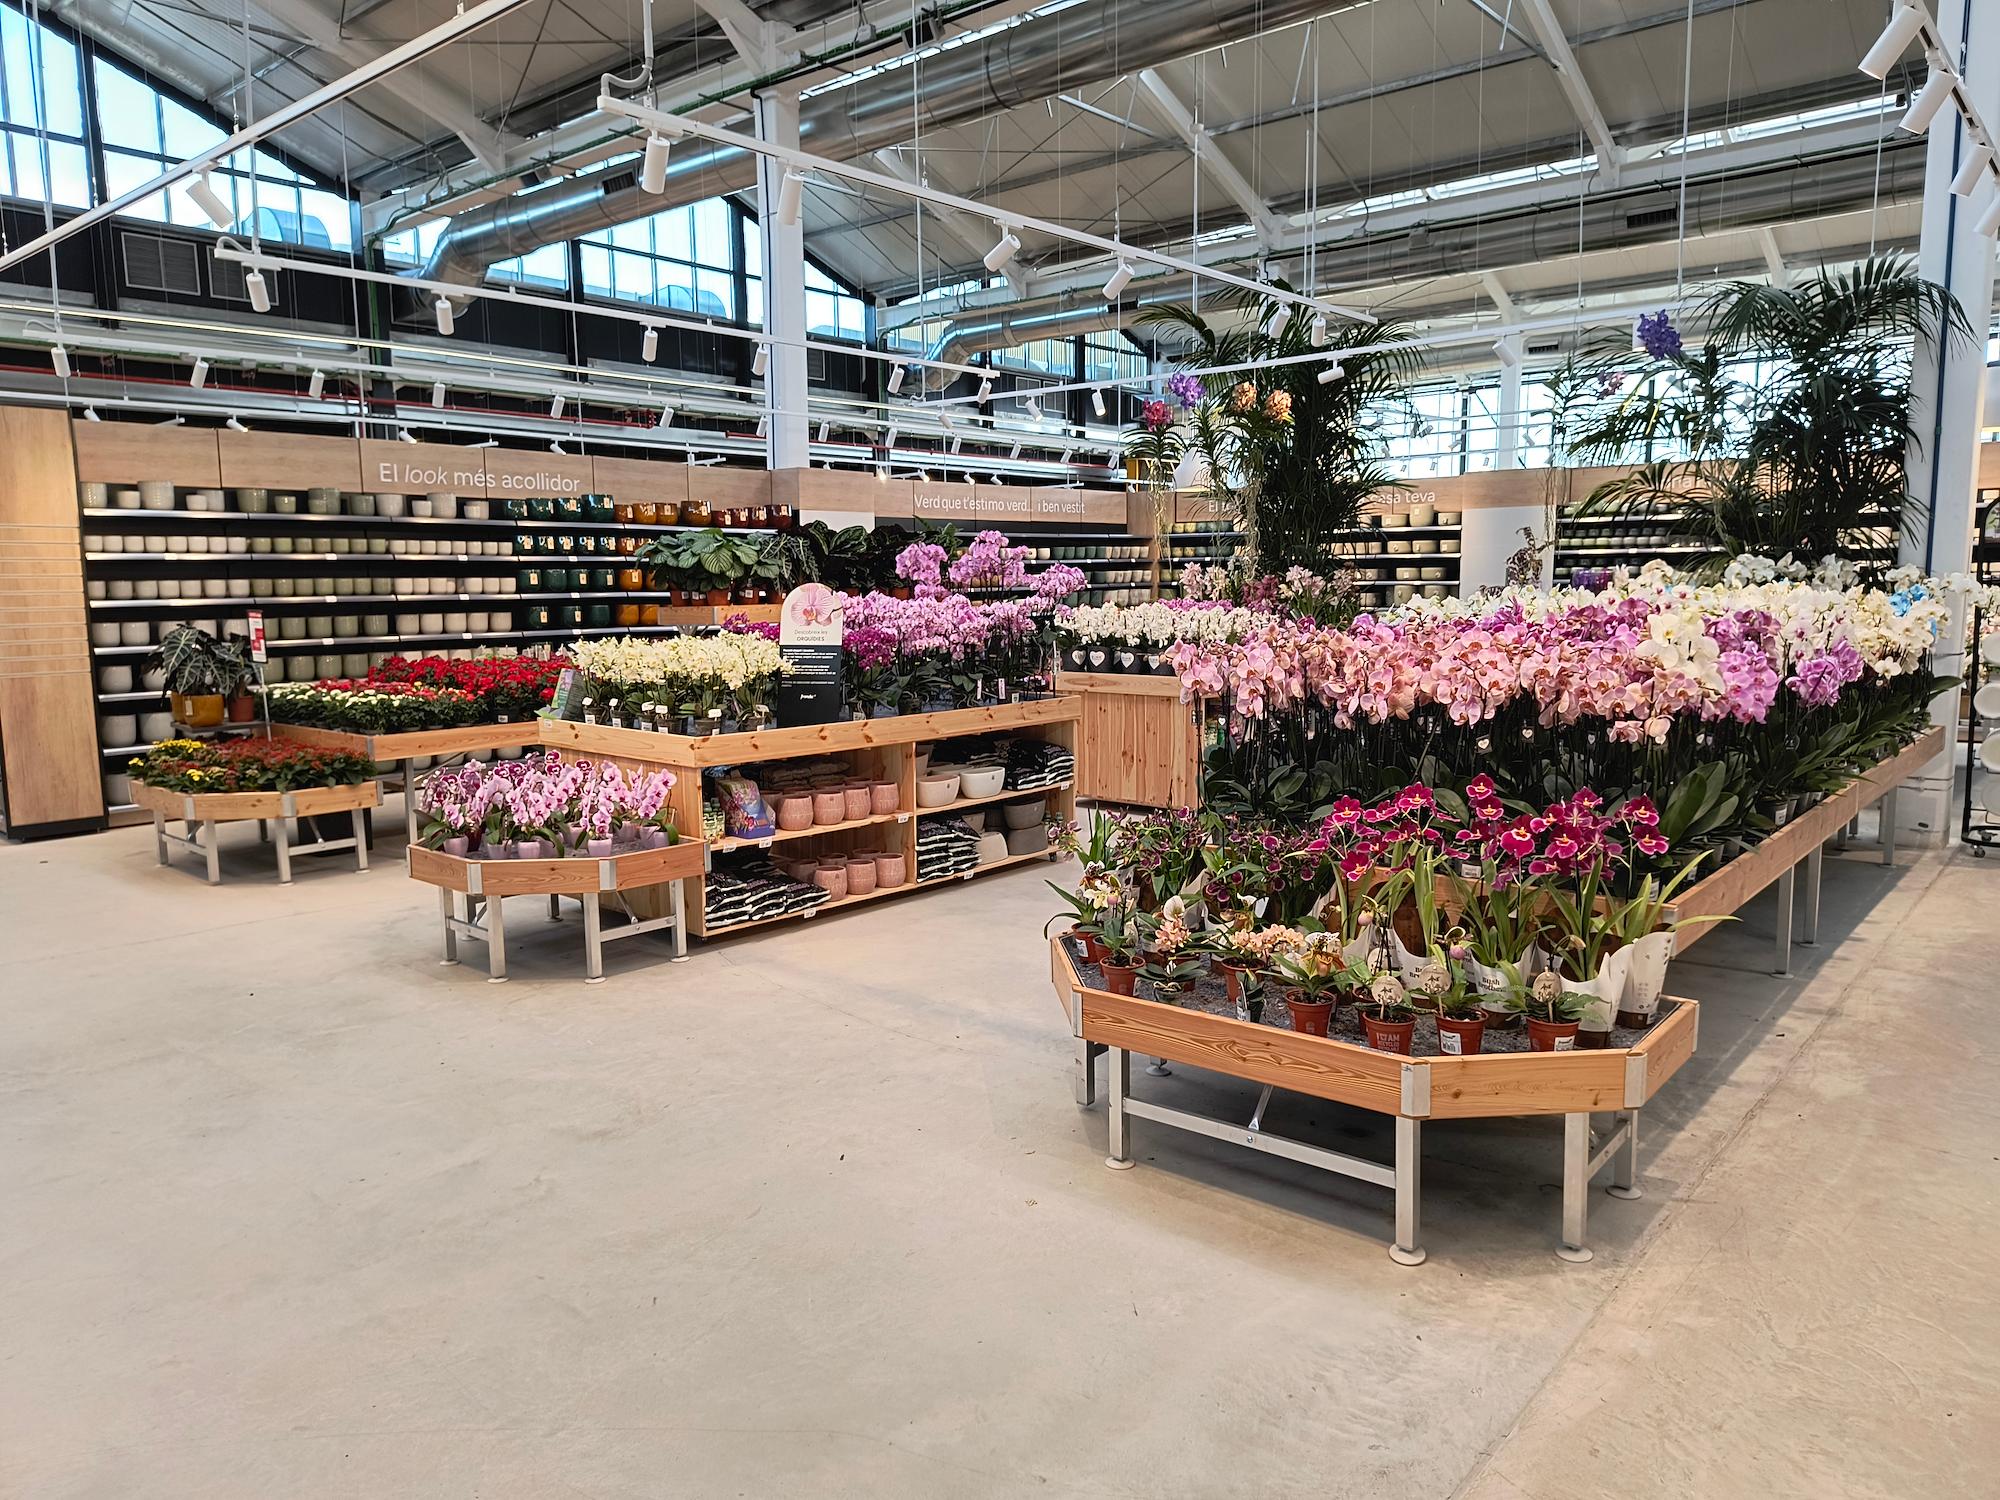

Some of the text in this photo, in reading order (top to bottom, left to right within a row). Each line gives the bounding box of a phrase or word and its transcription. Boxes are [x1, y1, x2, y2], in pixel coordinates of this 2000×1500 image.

[379, 462, 581, 492] El look més acollidor
[914, 494, 941, 509] Verd
[941, 497, 962, 512] que
[963, 496, 1005, 512] t'estimo
[1042, 500, 1060, 513] ben
[1061, 501, 1086, 514] vestit
[1208, 500, 1219, 512] El
[1405, 491, 1436, 503] teva
